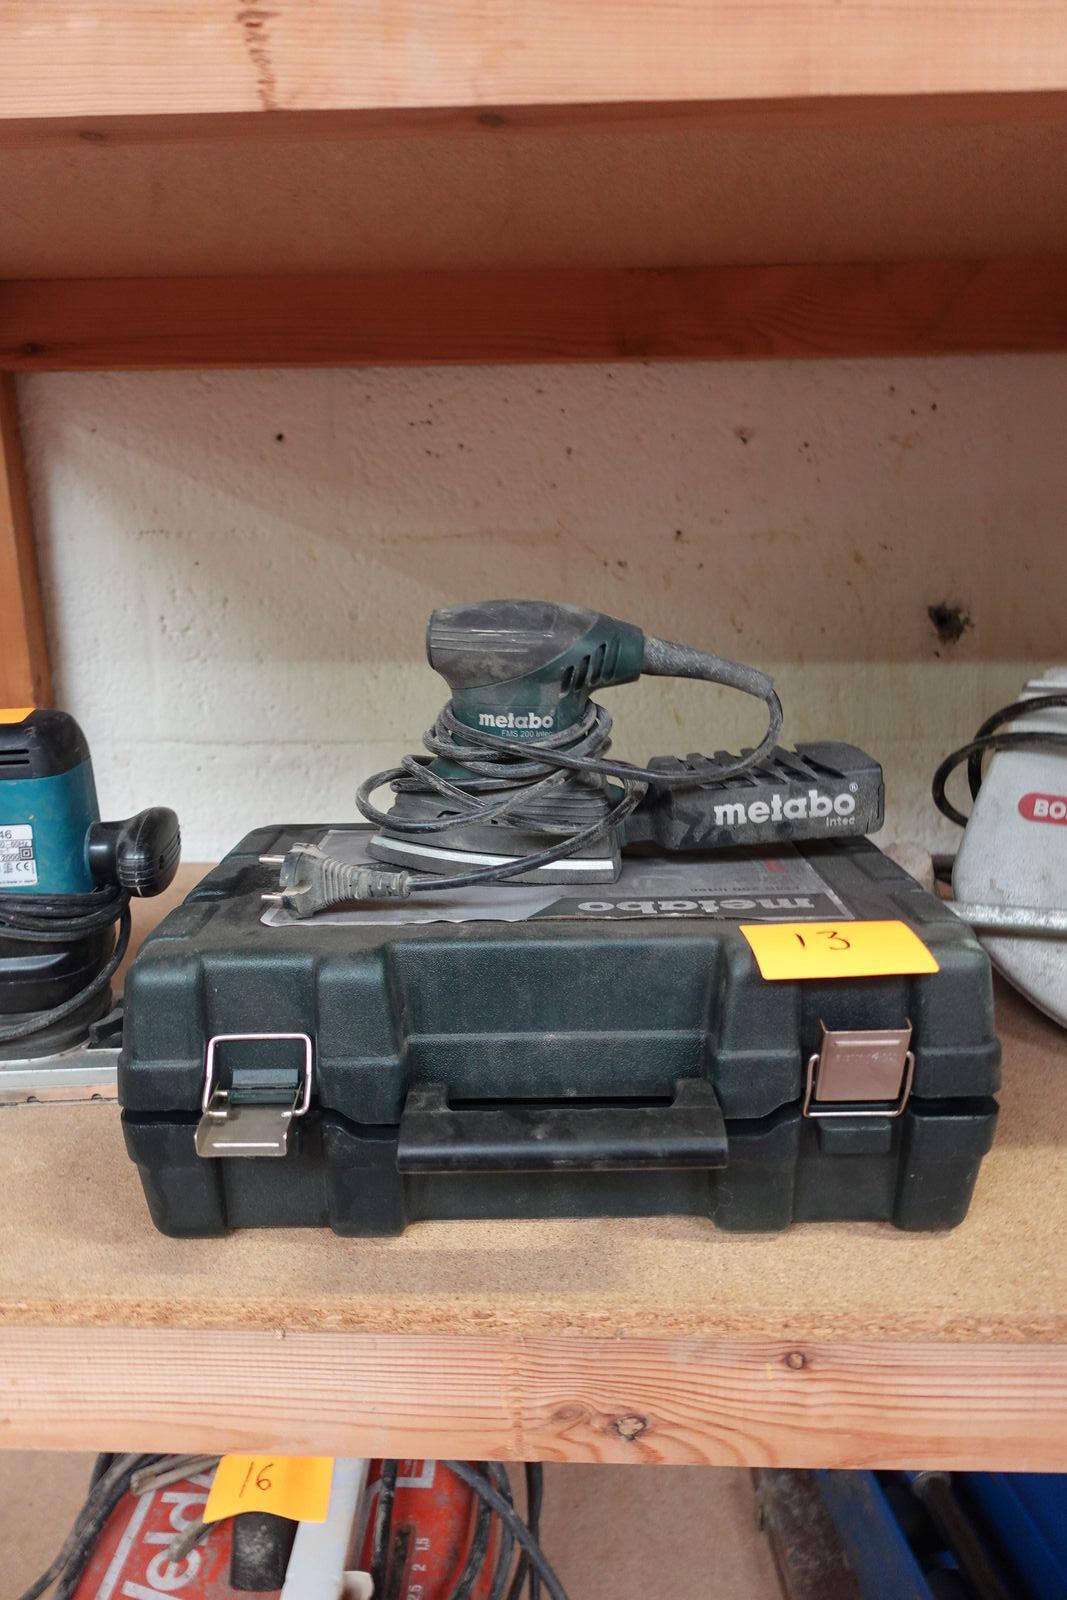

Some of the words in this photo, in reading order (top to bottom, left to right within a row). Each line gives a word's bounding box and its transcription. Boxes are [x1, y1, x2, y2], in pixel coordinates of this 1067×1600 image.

[478, 712, 554, 729] metabo
[501, 730, 519, 738] FMS
[520, 730, 534, 738] 200
[713, 789, 856, 826] metabo
[1033, 798, 1067, 819] BO
[577, 897, 815, 914] metabo
[796, 930, 851, 951] 13
[238, 1461, 275, 1498] 16
[411, 1563, 427, 1572] 2
